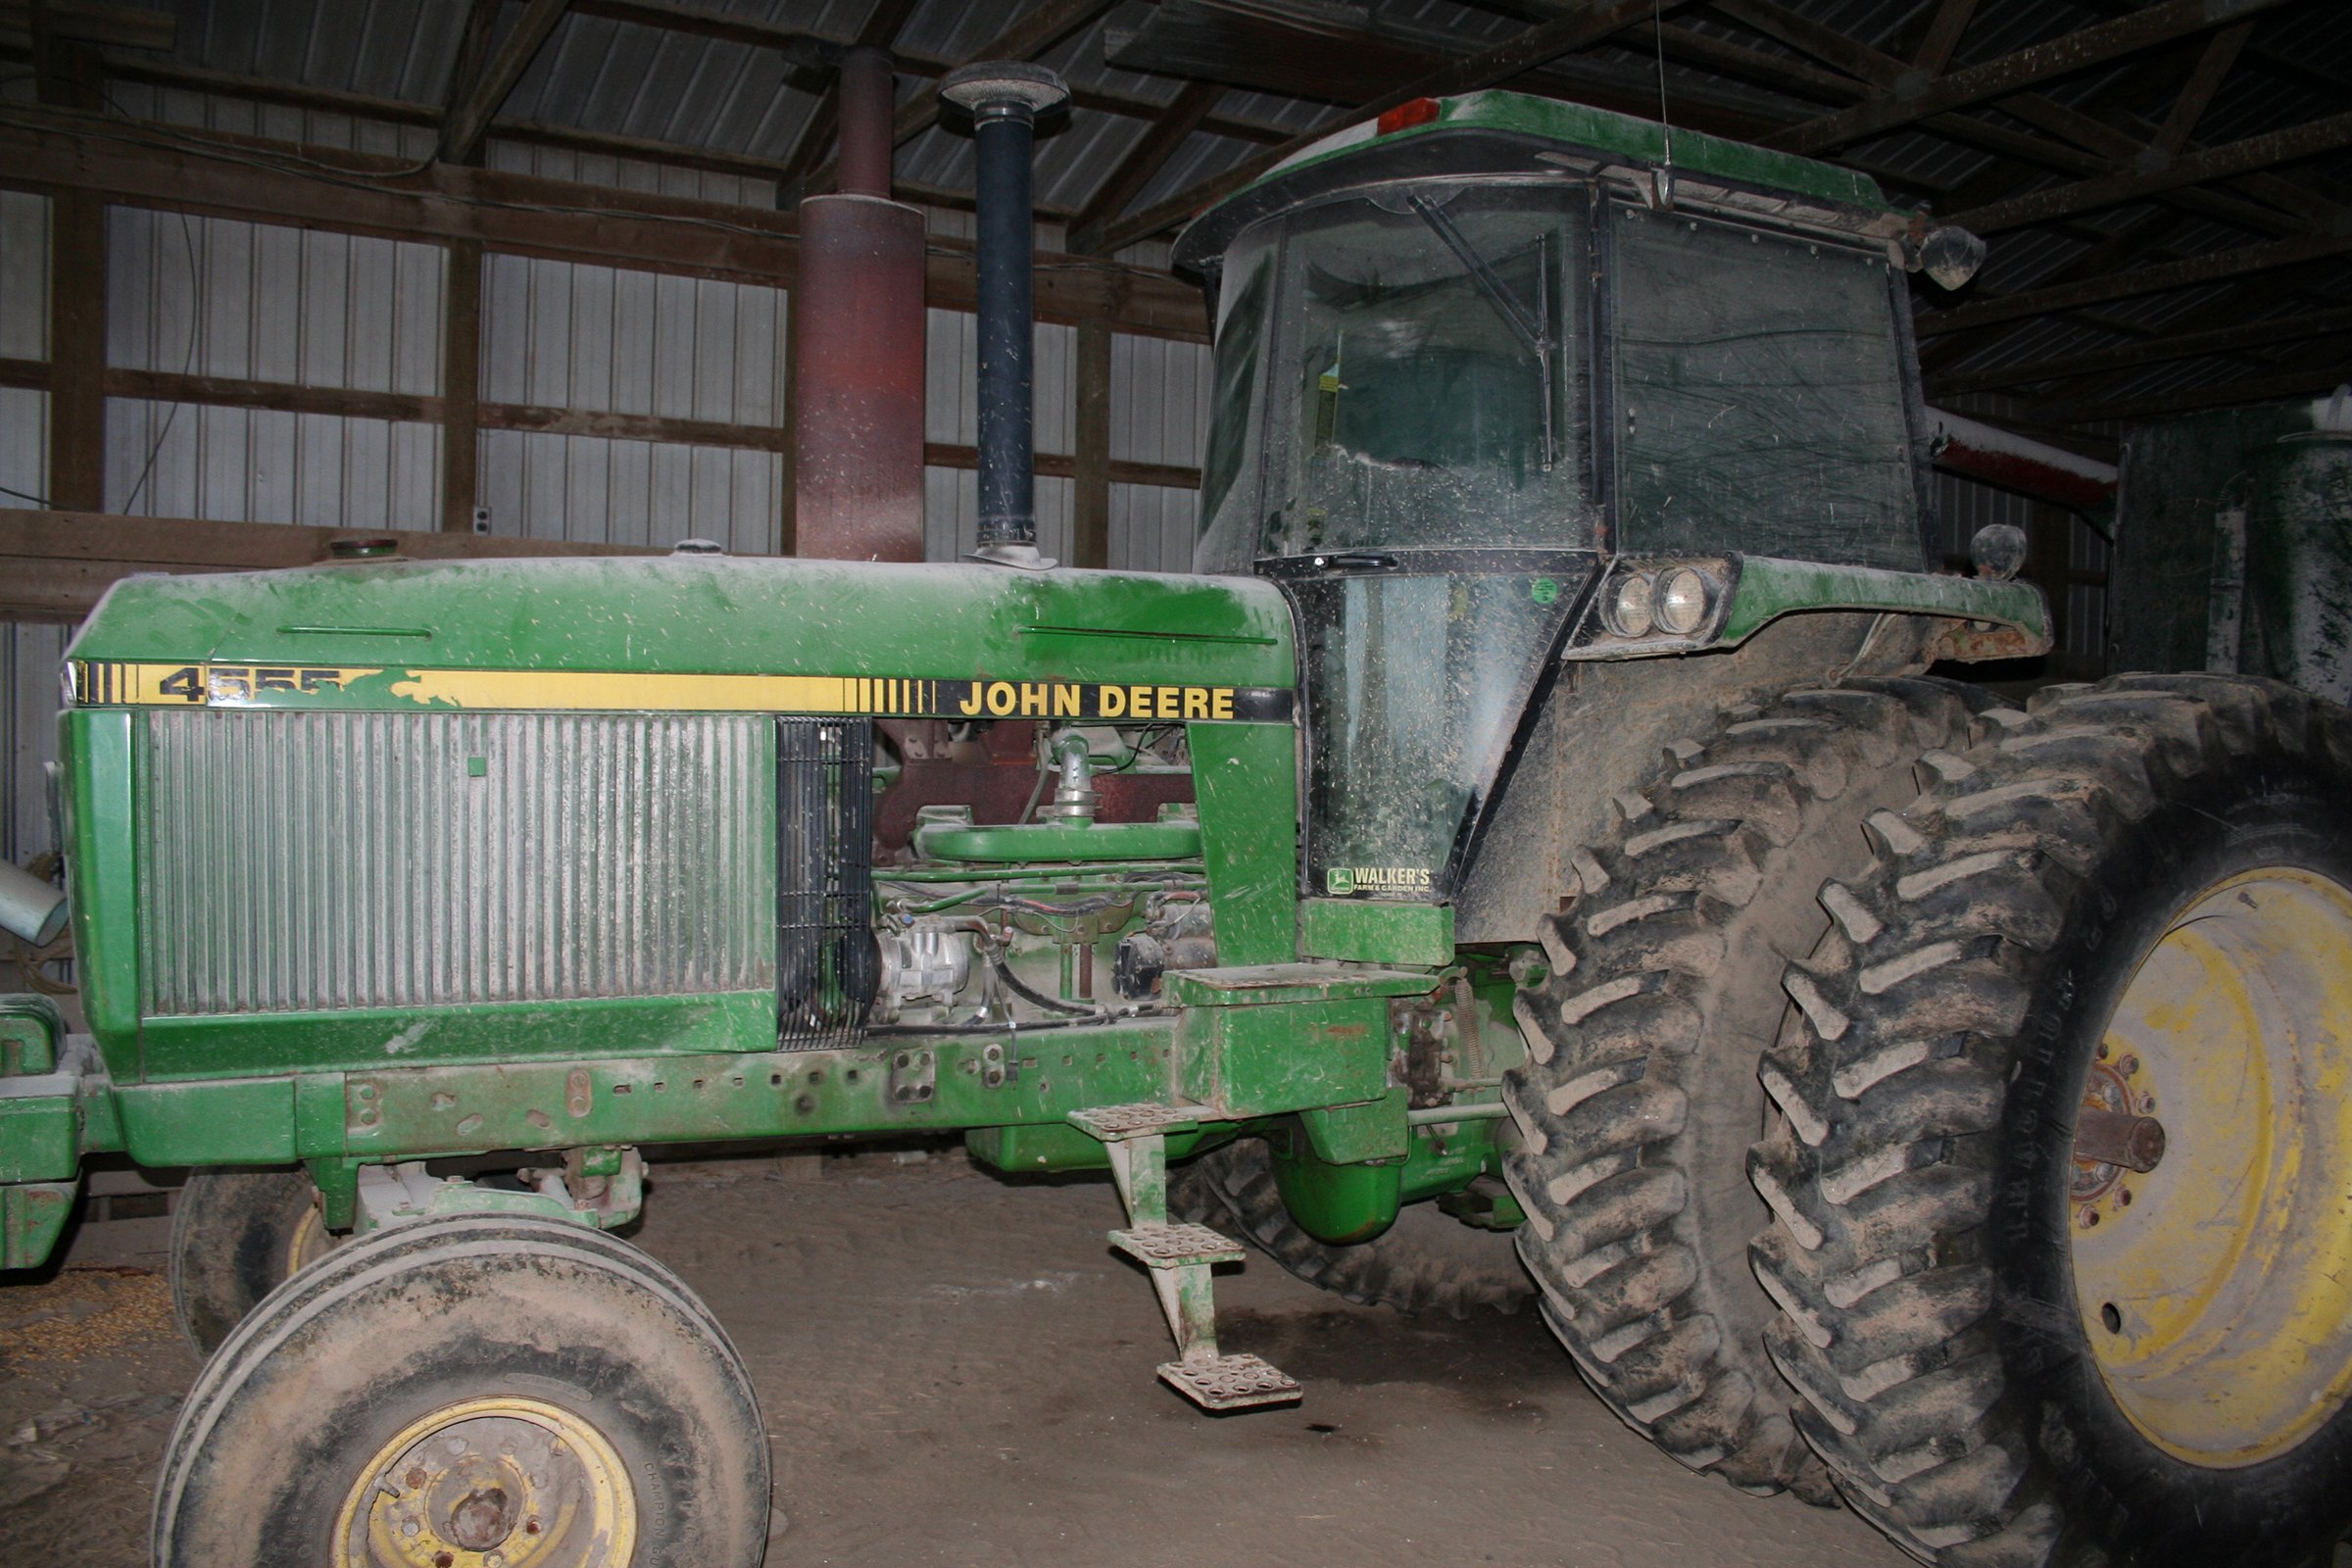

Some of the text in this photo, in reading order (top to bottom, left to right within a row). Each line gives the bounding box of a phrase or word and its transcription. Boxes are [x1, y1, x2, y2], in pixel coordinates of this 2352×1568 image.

[960, 681, 1235, 719] JOHN DEERE
[1355, 867, 1430, 885] WALKER'S
[644, 1461, 665, 1538] CHAMPION
